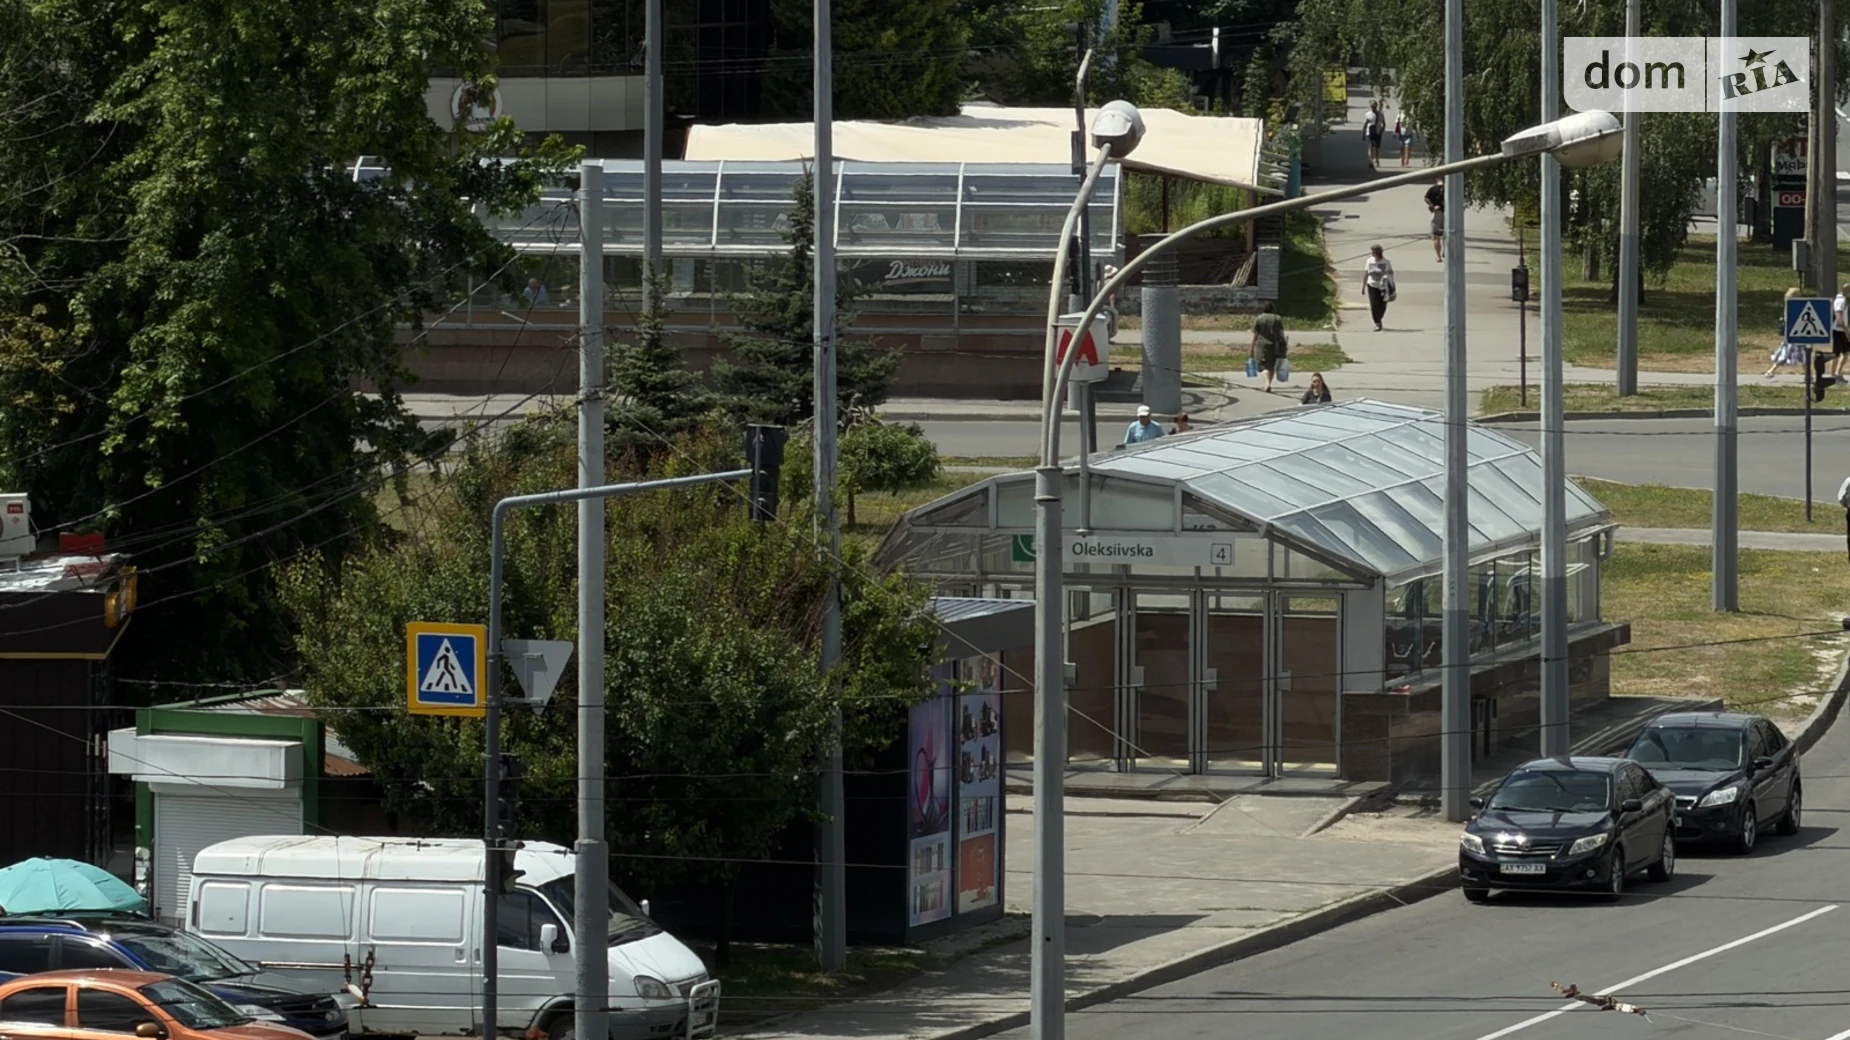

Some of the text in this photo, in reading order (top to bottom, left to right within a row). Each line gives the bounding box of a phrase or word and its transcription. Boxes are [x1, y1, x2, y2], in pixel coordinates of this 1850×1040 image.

[884, 260, 951, 279] Джони
[1072, 542, 1226, 561] Oleksiivska 4
